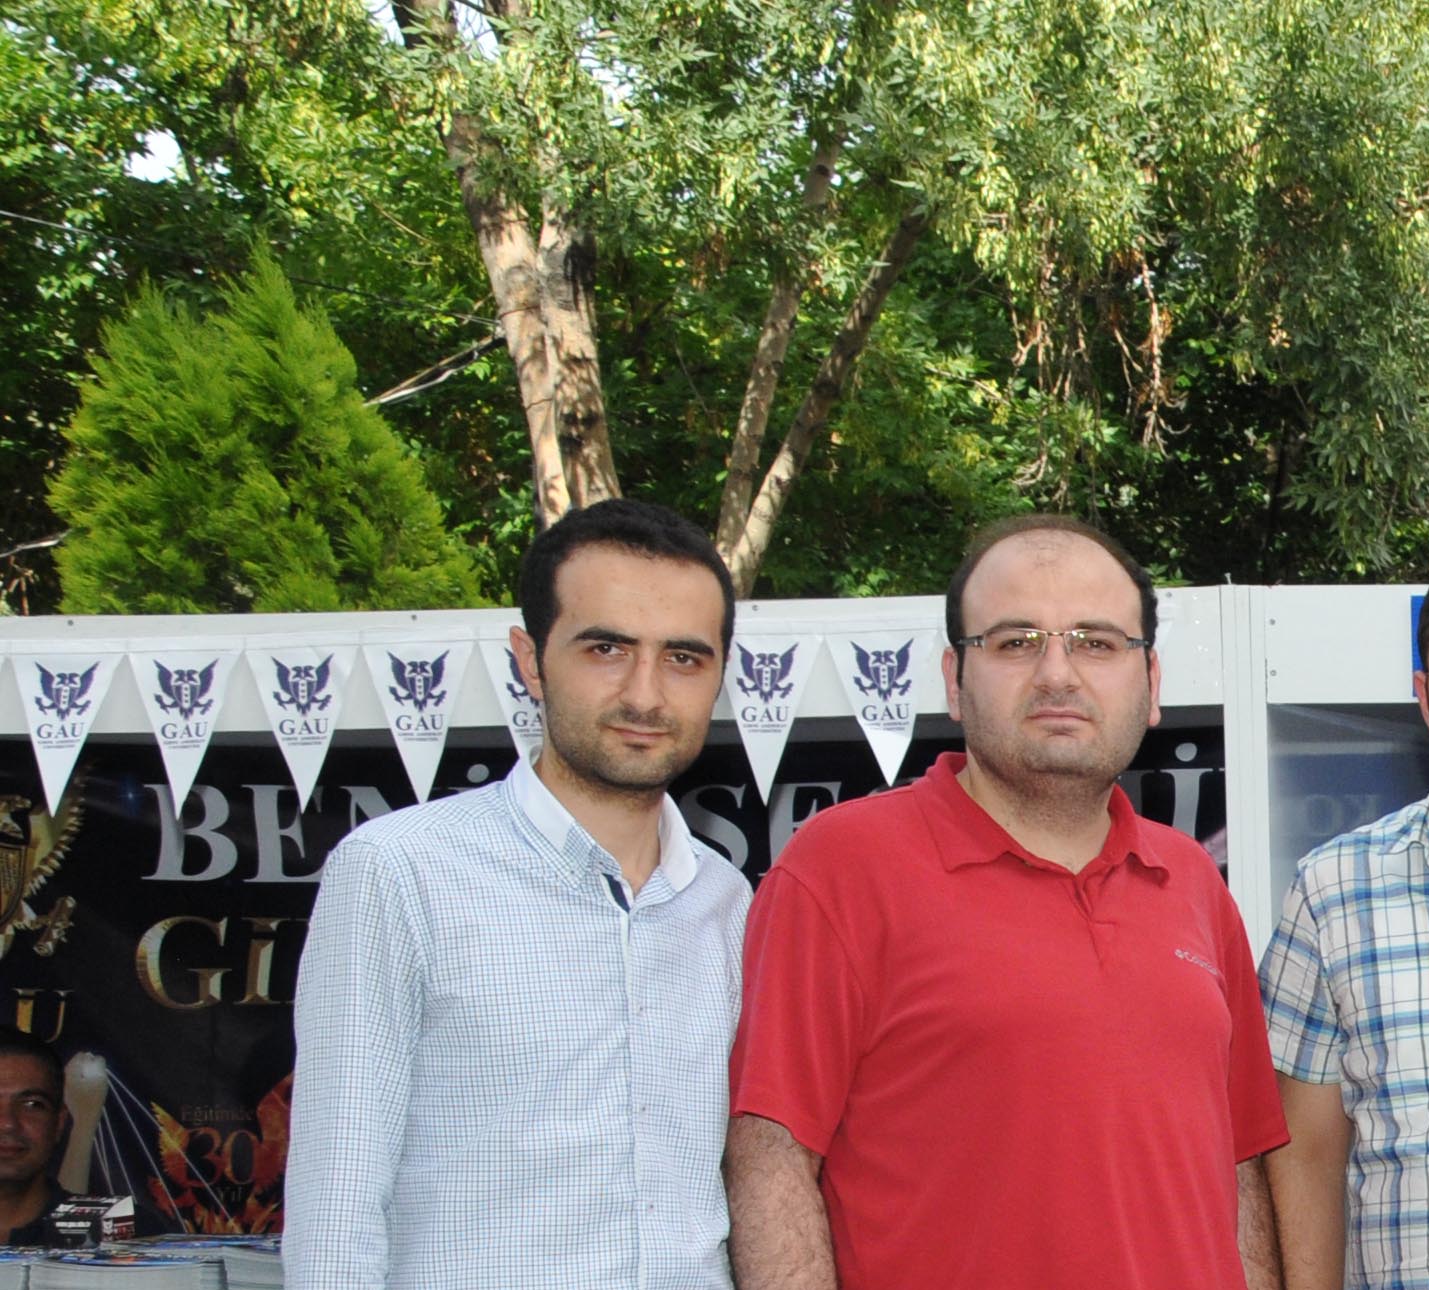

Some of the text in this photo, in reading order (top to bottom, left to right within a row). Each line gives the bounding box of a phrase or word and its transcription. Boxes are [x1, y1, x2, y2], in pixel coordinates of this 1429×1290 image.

[741, 705, 791, 723] GAU
[861, 703, 911, 722] GAU
[36, 721, 85, 741] GAU
[160, 721, 208, 740] GAU
[278, 718, 329, 736] GAU
[395, 713, 445, 732] GAU
